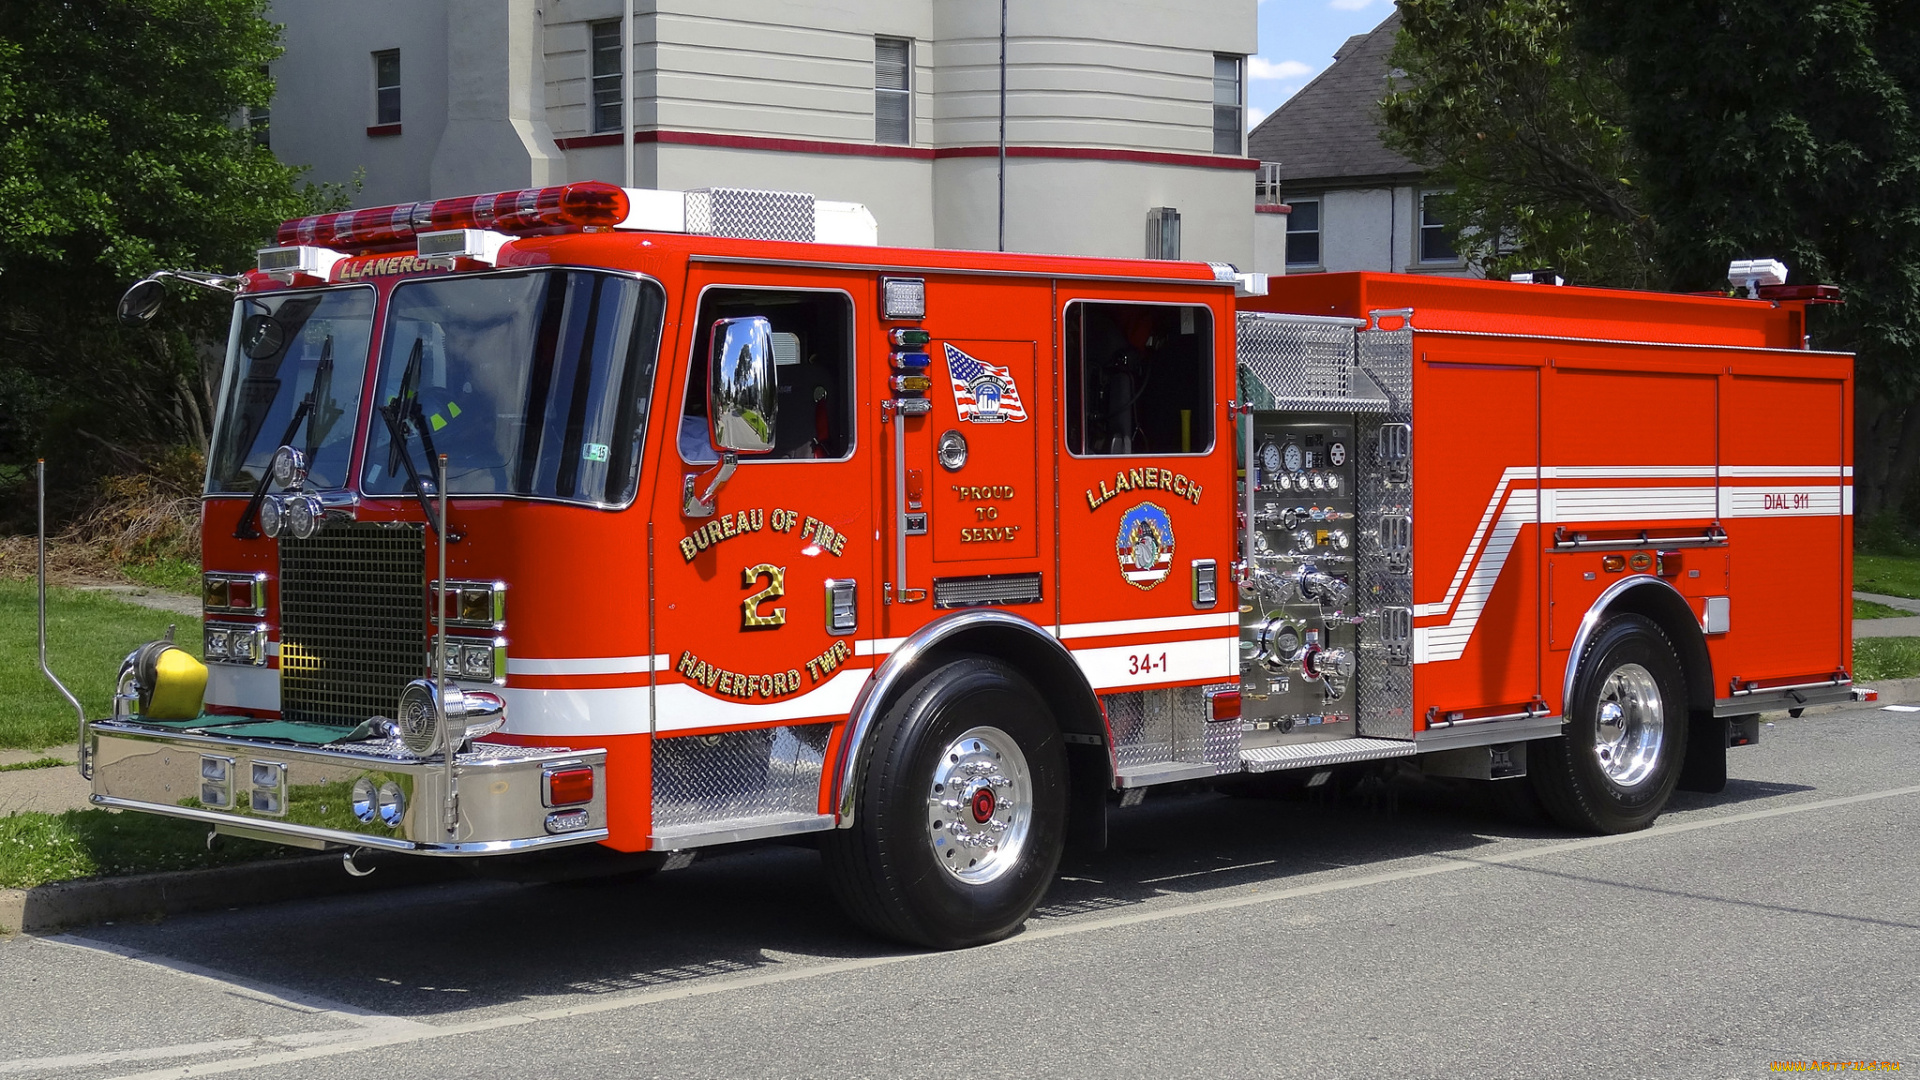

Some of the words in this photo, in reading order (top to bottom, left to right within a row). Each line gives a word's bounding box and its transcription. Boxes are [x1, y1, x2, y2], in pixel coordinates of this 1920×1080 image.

[1086, 467, 1202, 509] LLANERCH
[1764, 494, 1790, 510] DIAL
[1793, 493, 1809, 510] 911
[976, 506, 998, 520] TO
[679, 508, 763, 561] BUREAU
[770, 508, 798, 533] OF
[800, 515, 848, 557] FIRE
[744, 563, 786, 627] 2
[678, 650, 801, 697] HAVERFORD
[806, 639, 852, 681] TWP.
[1129, 652, 1166, 675] 34-1
